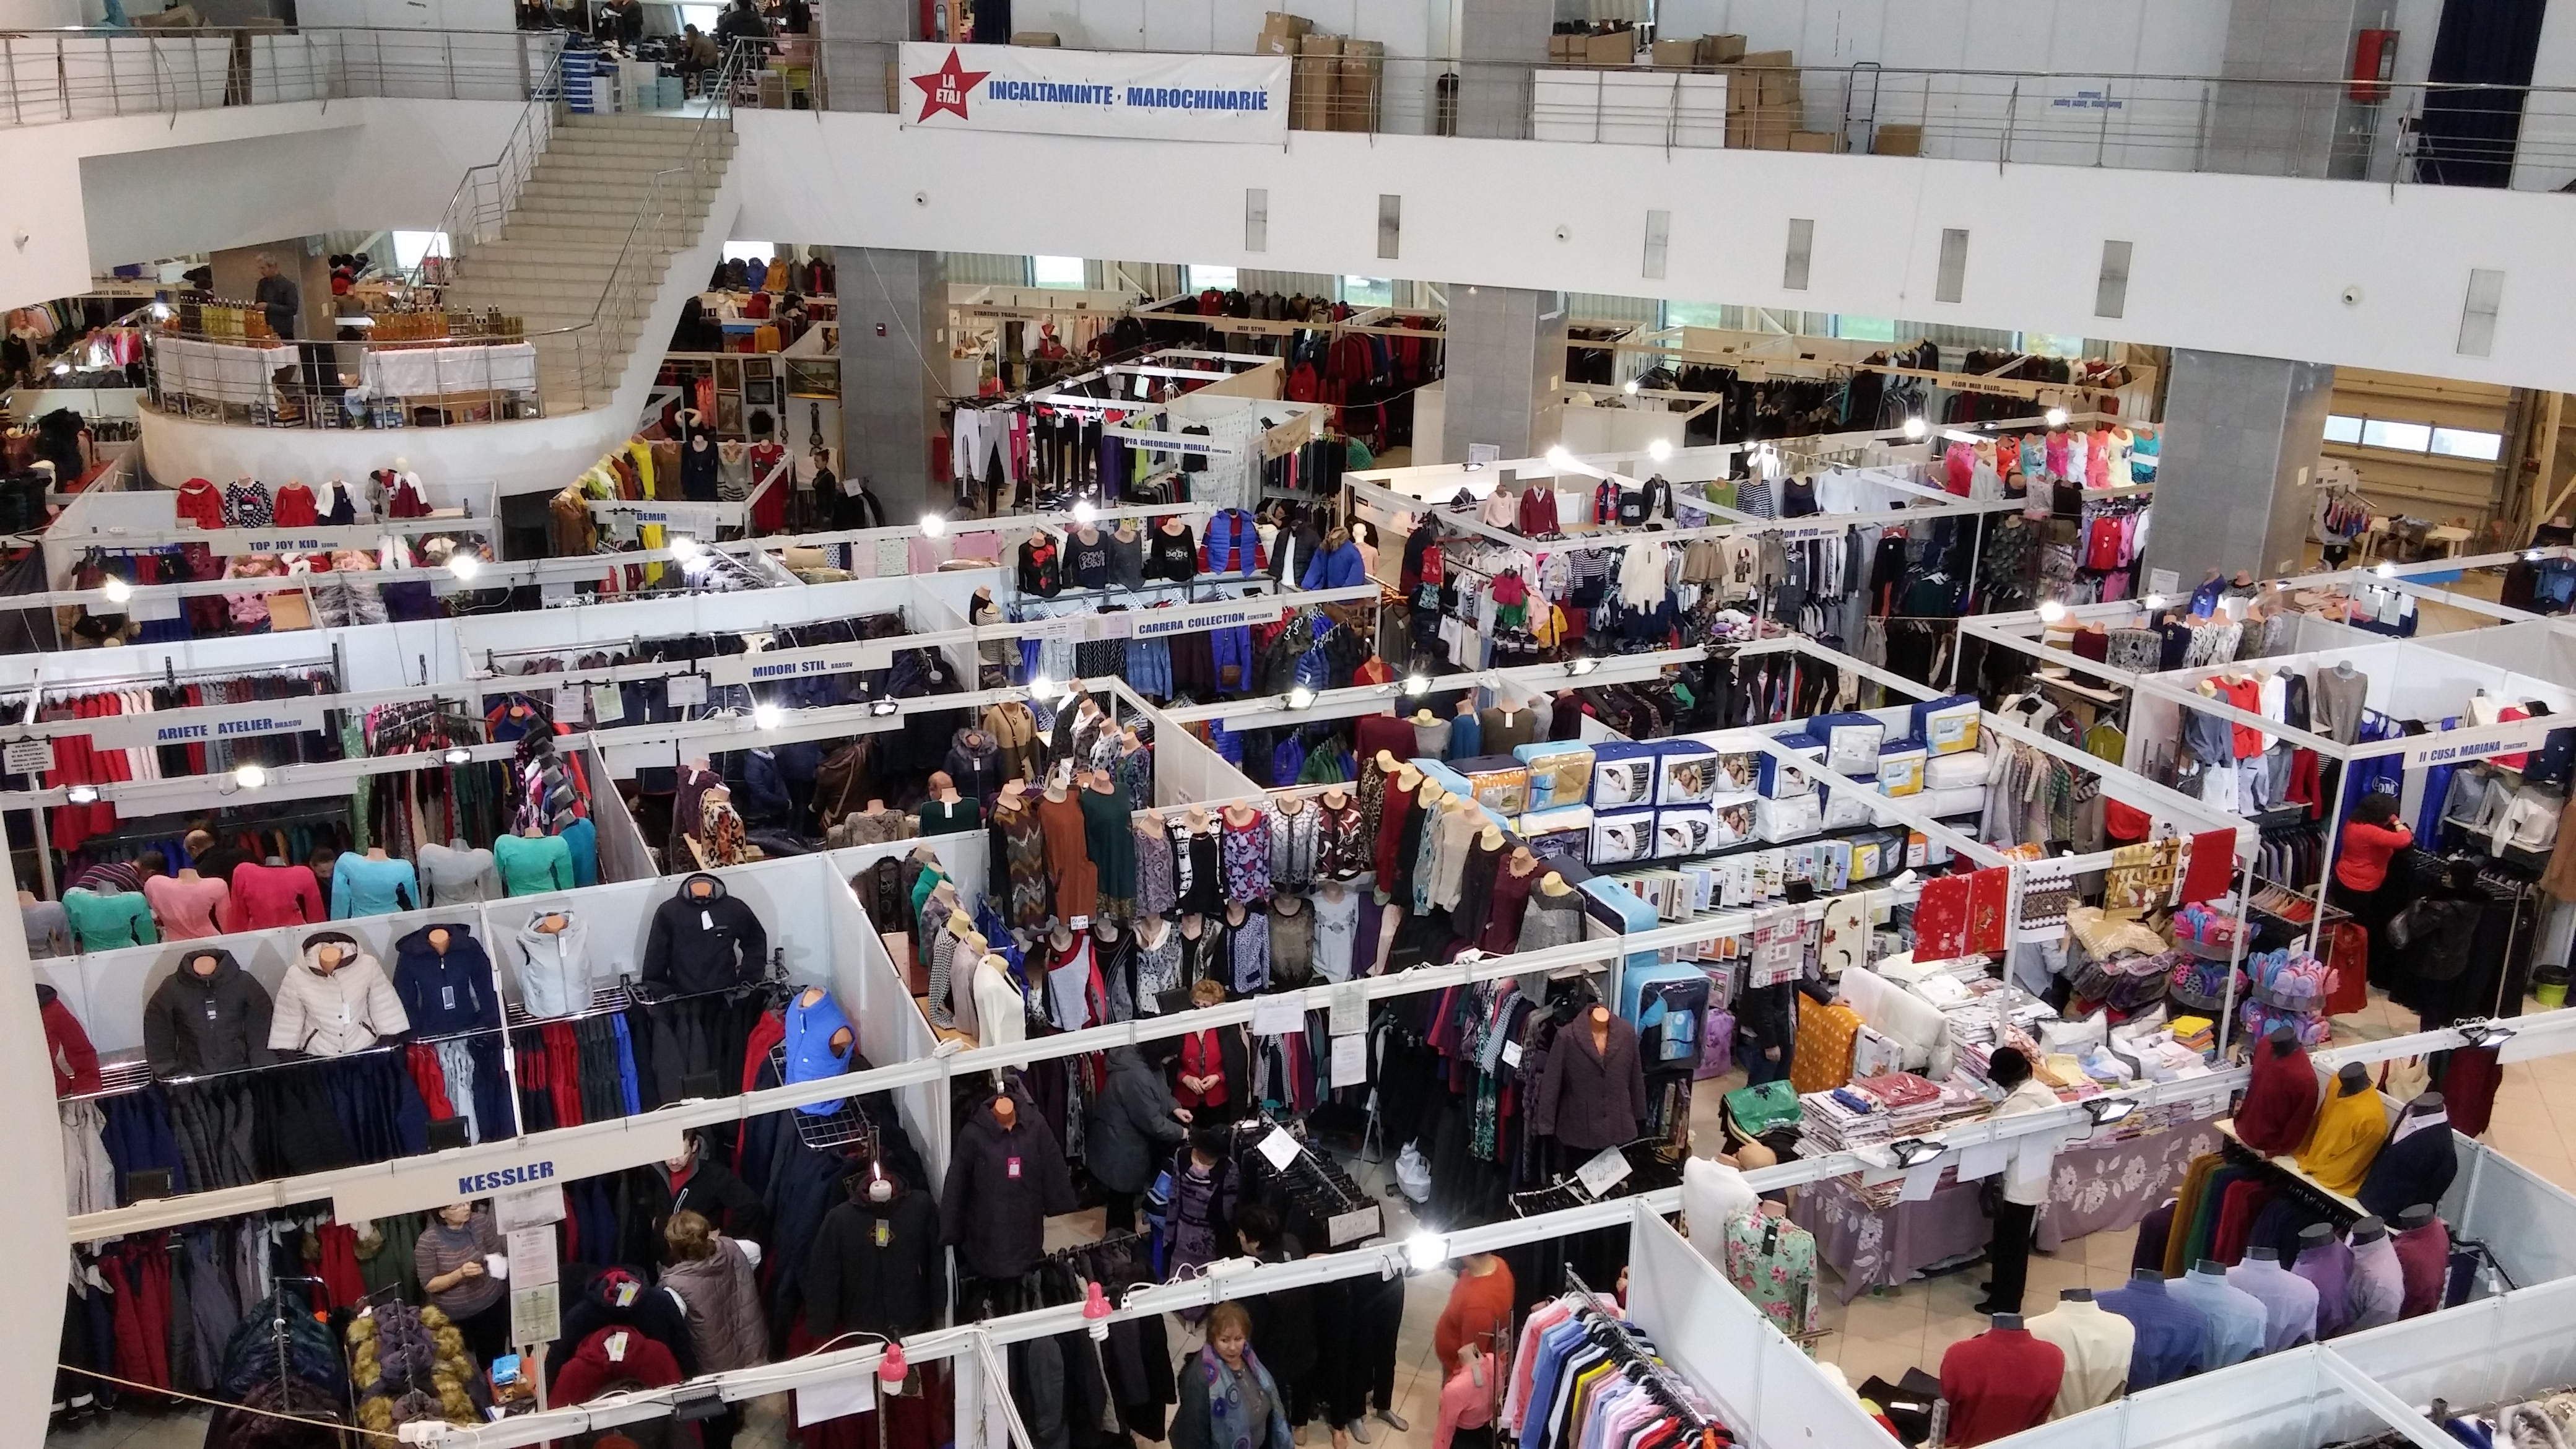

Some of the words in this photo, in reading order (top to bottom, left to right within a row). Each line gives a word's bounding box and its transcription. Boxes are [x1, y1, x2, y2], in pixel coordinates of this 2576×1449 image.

[942, 74, 955, 88] LA
[936, 88, 960, 104] ETAJ
[990, 80, 1113, 105] INCALTAMINTE
[1127, 87, 1268, 110] MAROCHINARIE
[1984, 384, 2000, 392] ELLIS
[1125, 437, 1138, 445] PFA
[1140, 438, 1181, 450] GHEORGHIU
[1184, 443, 1211, 452] MIRELA
[637, 513, 666, 521] DEMIR
[1799, 528, 1818, 537] PROD
[249, 541, 270, 551] TOP
[276, 541, 294, 550] JOY
[299, 539, 318, 549] KID
[1139, 620, 1183, 634] CARRERA
[1188, 612, 1245, 628] COLLECTION
[1247, 612, 1273, 620] CONSTANTA
[752, 663, 796, 677] MIDORI
[802, 660, 826, 672] STIL
[158, 724, 208, 740] ARIETE
[218, 718, 272, 734] ATELIER
[274, 720, 302, 729] BRASOV
[2430, 747, 2456, 761] CUSA
[2460, 741, 2500, 757] MARIANA
[459, 1161, 554, 1194] KESSLER
